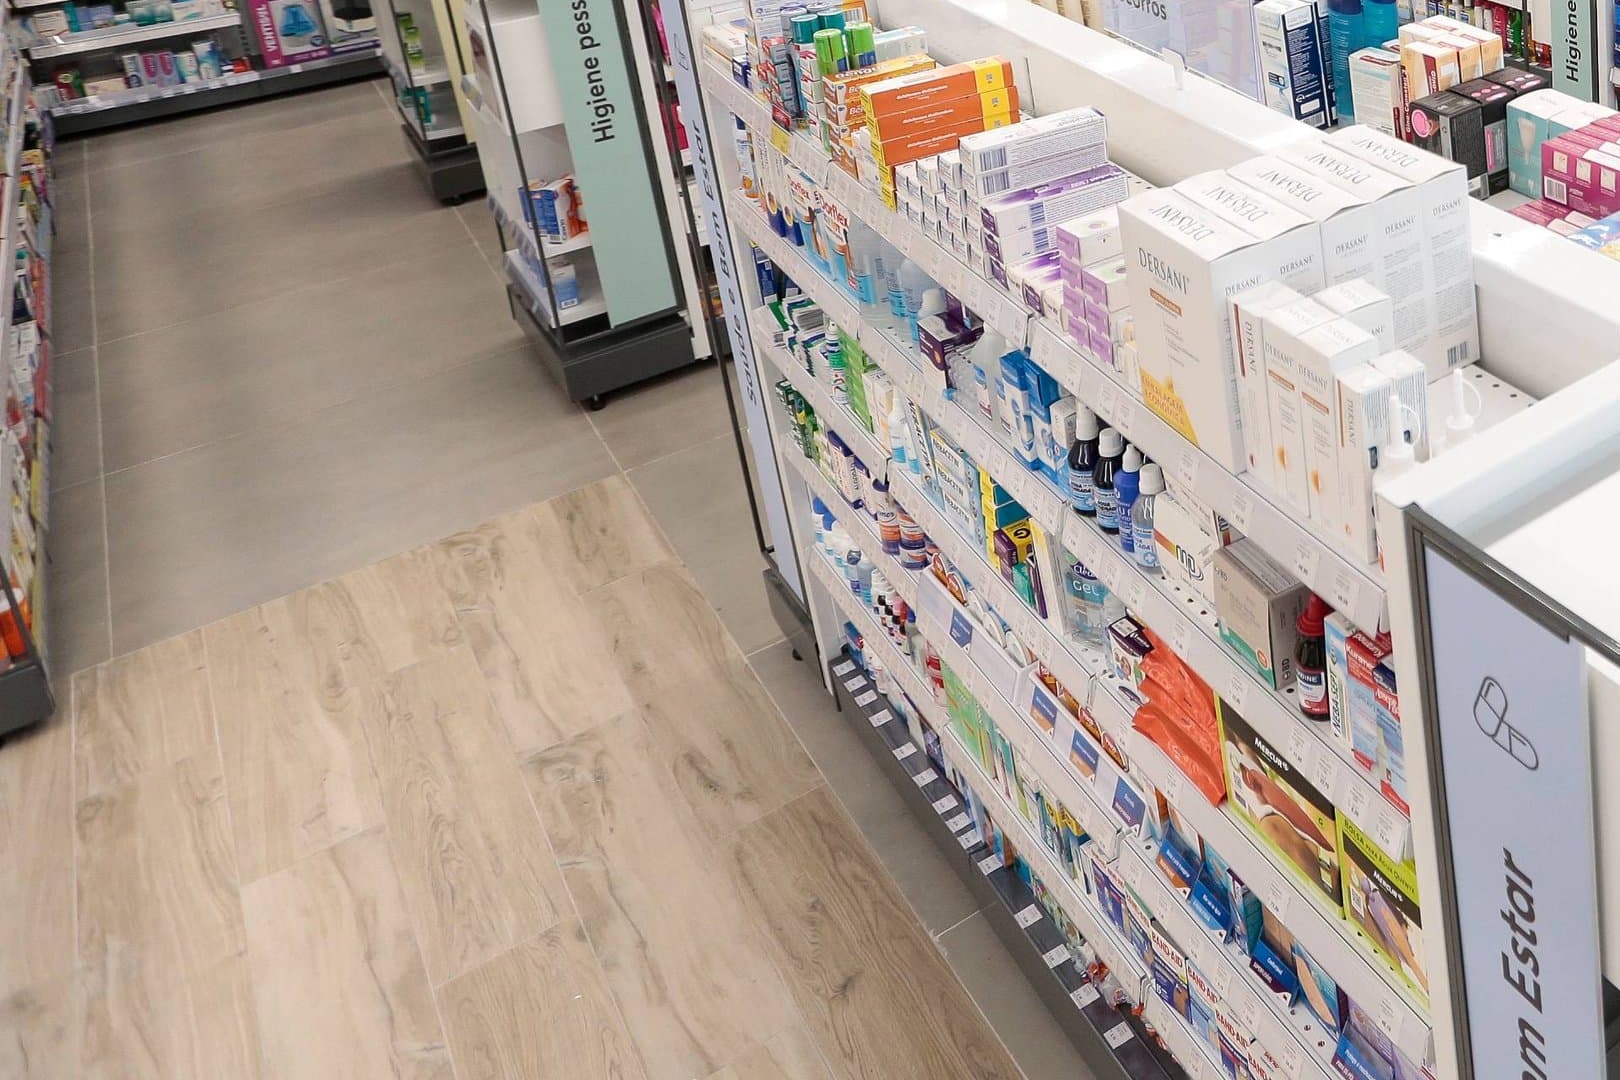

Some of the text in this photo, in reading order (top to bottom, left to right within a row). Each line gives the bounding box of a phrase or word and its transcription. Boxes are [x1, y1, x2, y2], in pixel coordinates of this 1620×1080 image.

[1566, 0, 1581, 83] Higiene
[583, 53, 616, 145] Higiene
[691, 119, 714, 201] Estar
[712, 211, 731, 279] Bem
[1138, 247, 1188, 295] DERSANI
[1335, 234, 1369, 256] DERSANI
[1501, 847, 1544, 1015] Estar
